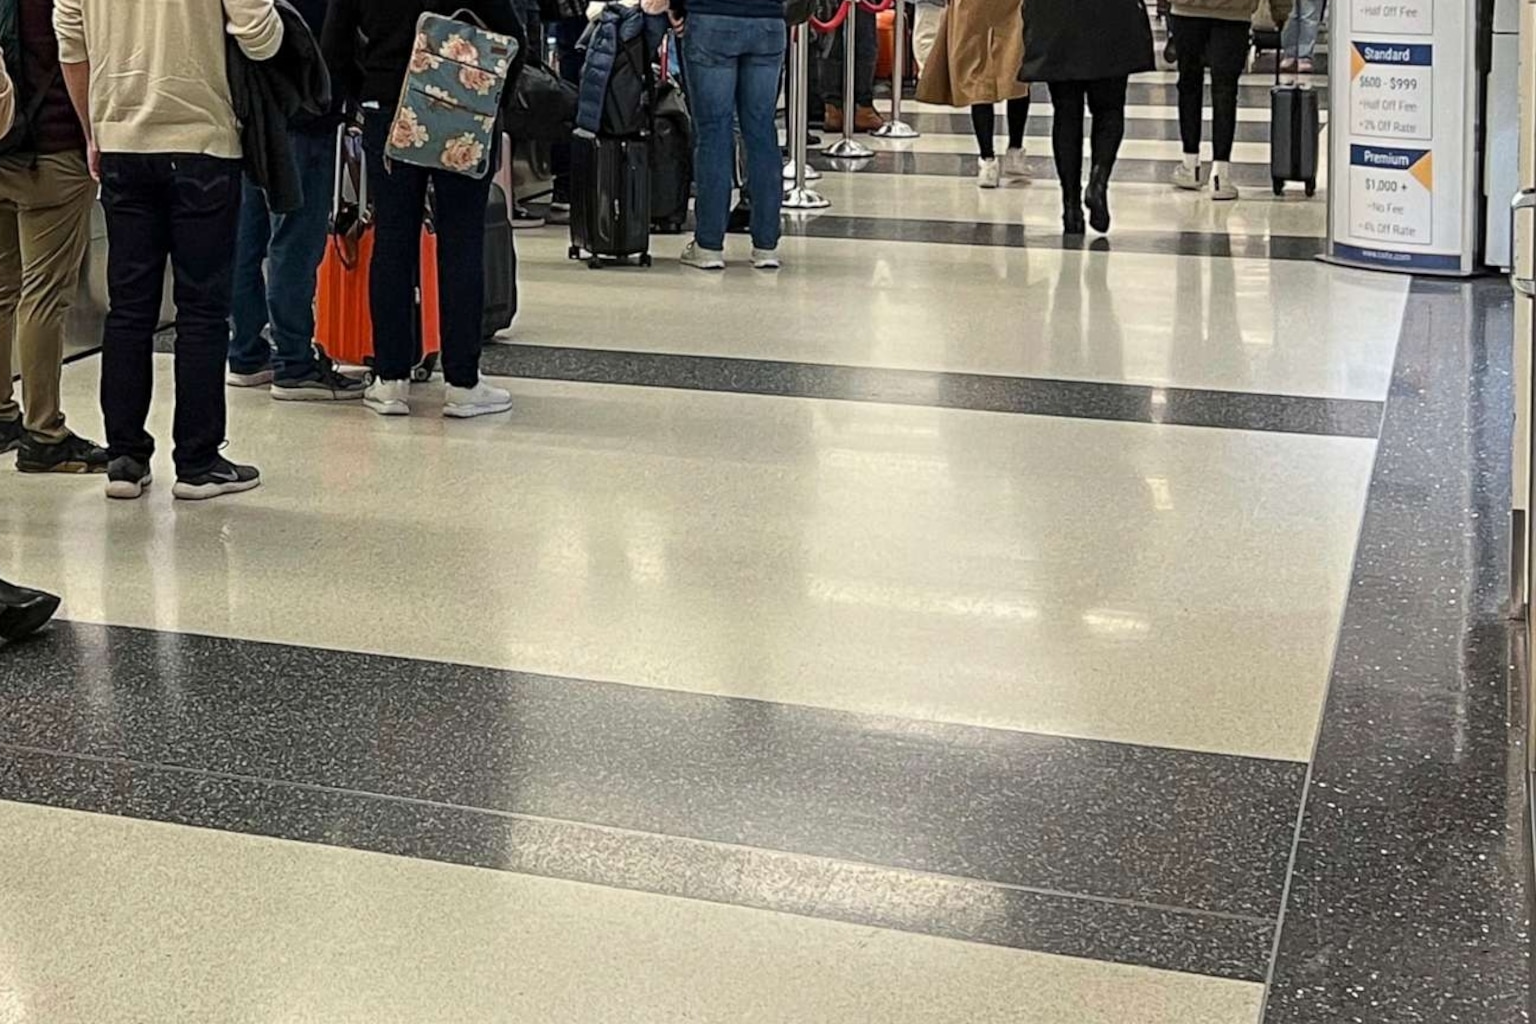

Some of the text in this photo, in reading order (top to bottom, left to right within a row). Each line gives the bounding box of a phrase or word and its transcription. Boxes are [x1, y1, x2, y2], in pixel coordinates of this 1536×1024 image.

[1400, 6, 1418, 18] Fee
[1364, 46, 1410, 61] Standard
[1390, 77, 1417, 90] $999
[1364, 150, 1409, 166] Premium
[1366, 178, 1408, 192] $1,000 +
